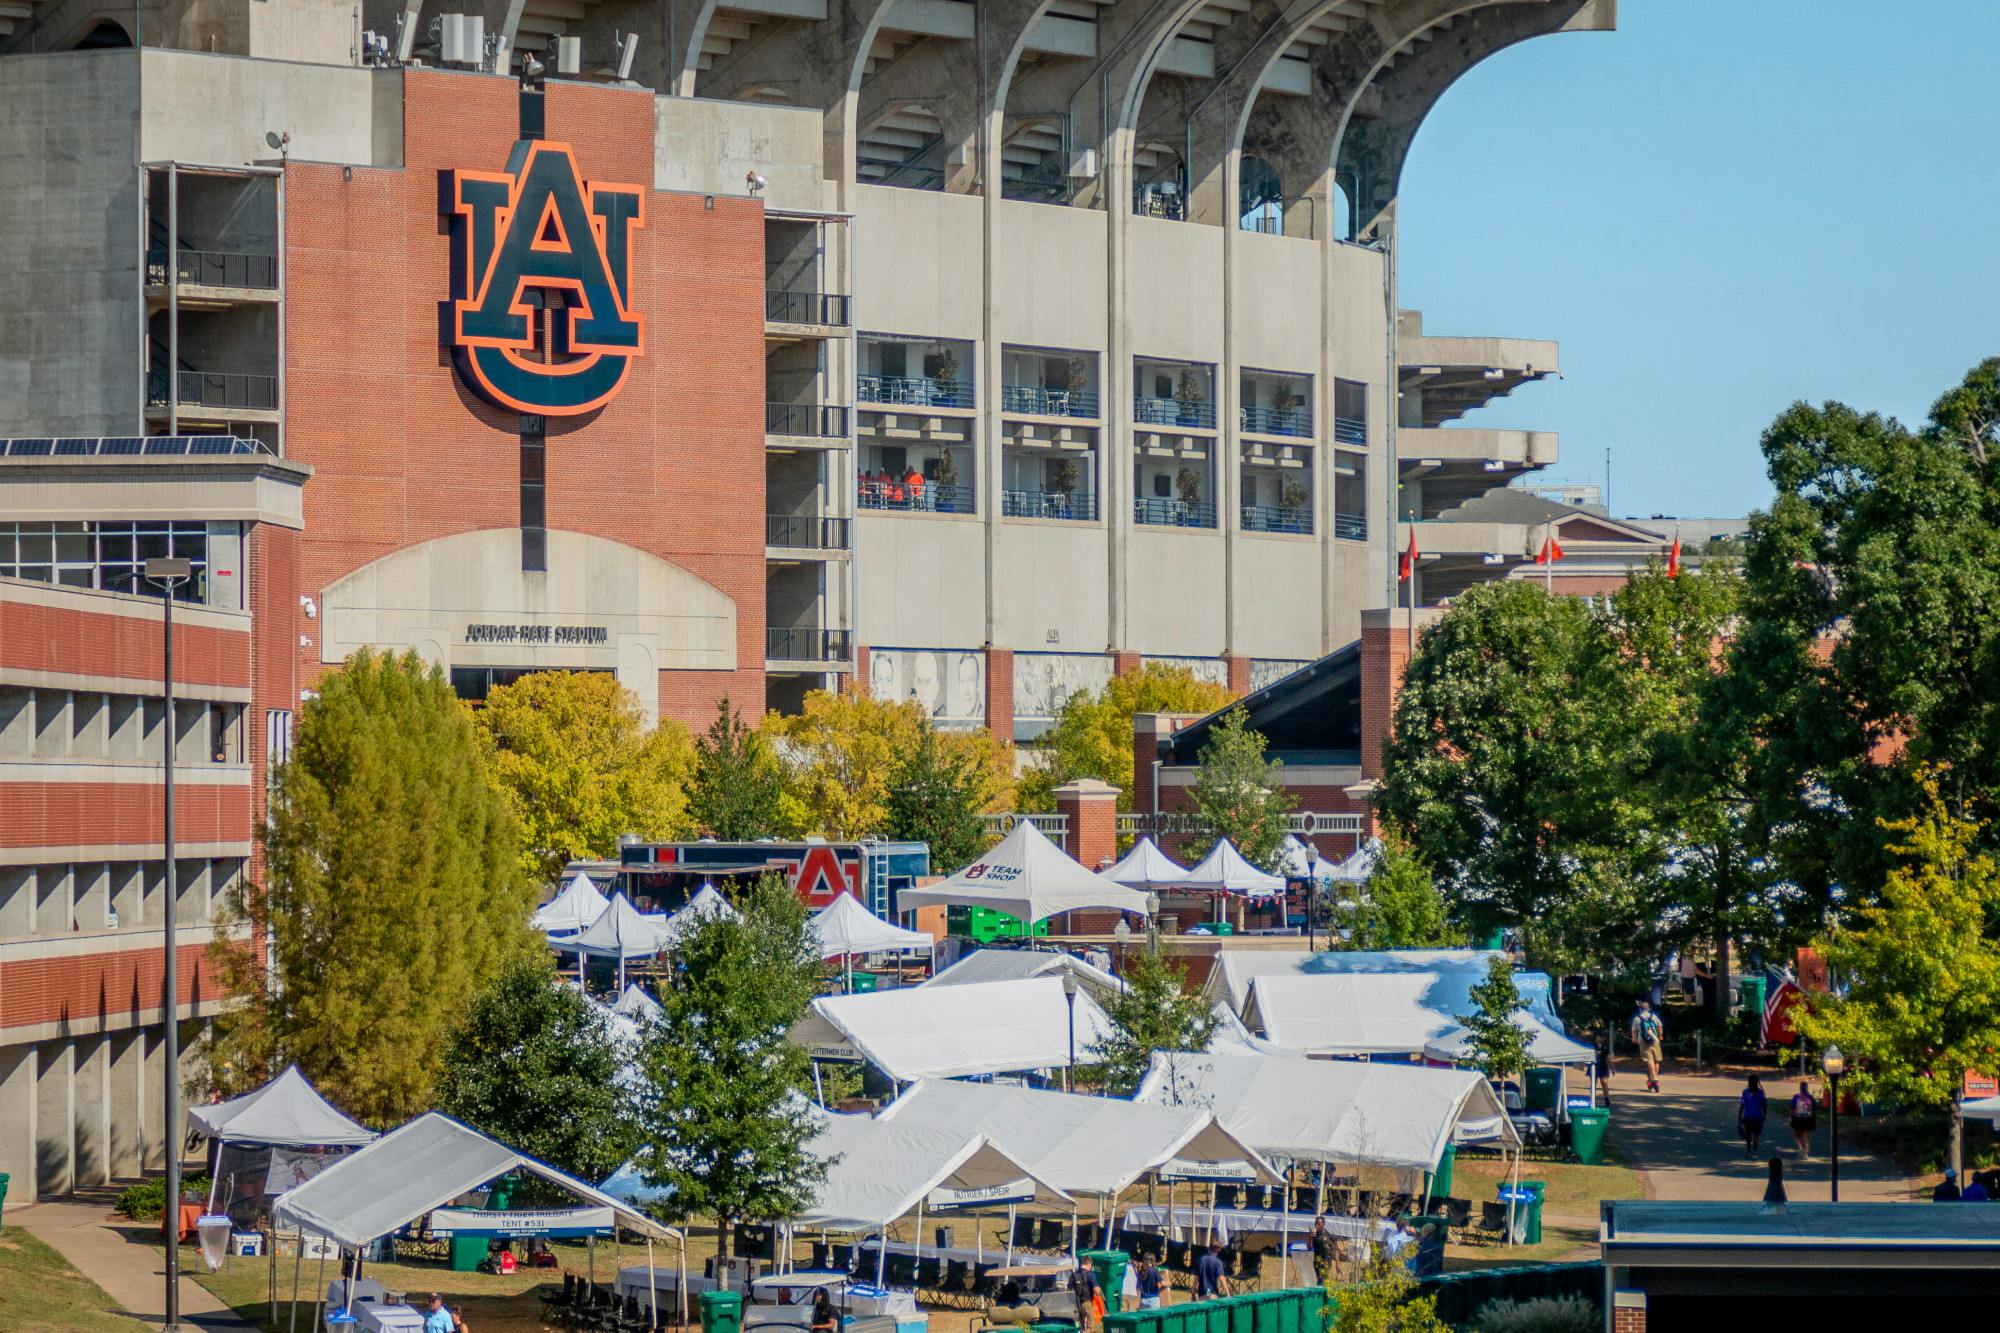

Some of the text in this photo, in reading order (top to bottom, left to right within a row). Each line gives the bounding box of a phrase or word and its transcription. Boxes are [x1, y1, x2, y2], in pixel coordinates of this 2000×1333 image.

[465, 624, 608, 645] JORDAN-HARE STADIUM
[992, 865, 1023, 876] TEAM
[985, 873, 1017, 881] SHOP
[501, 1220, 522, 1228] TENT
